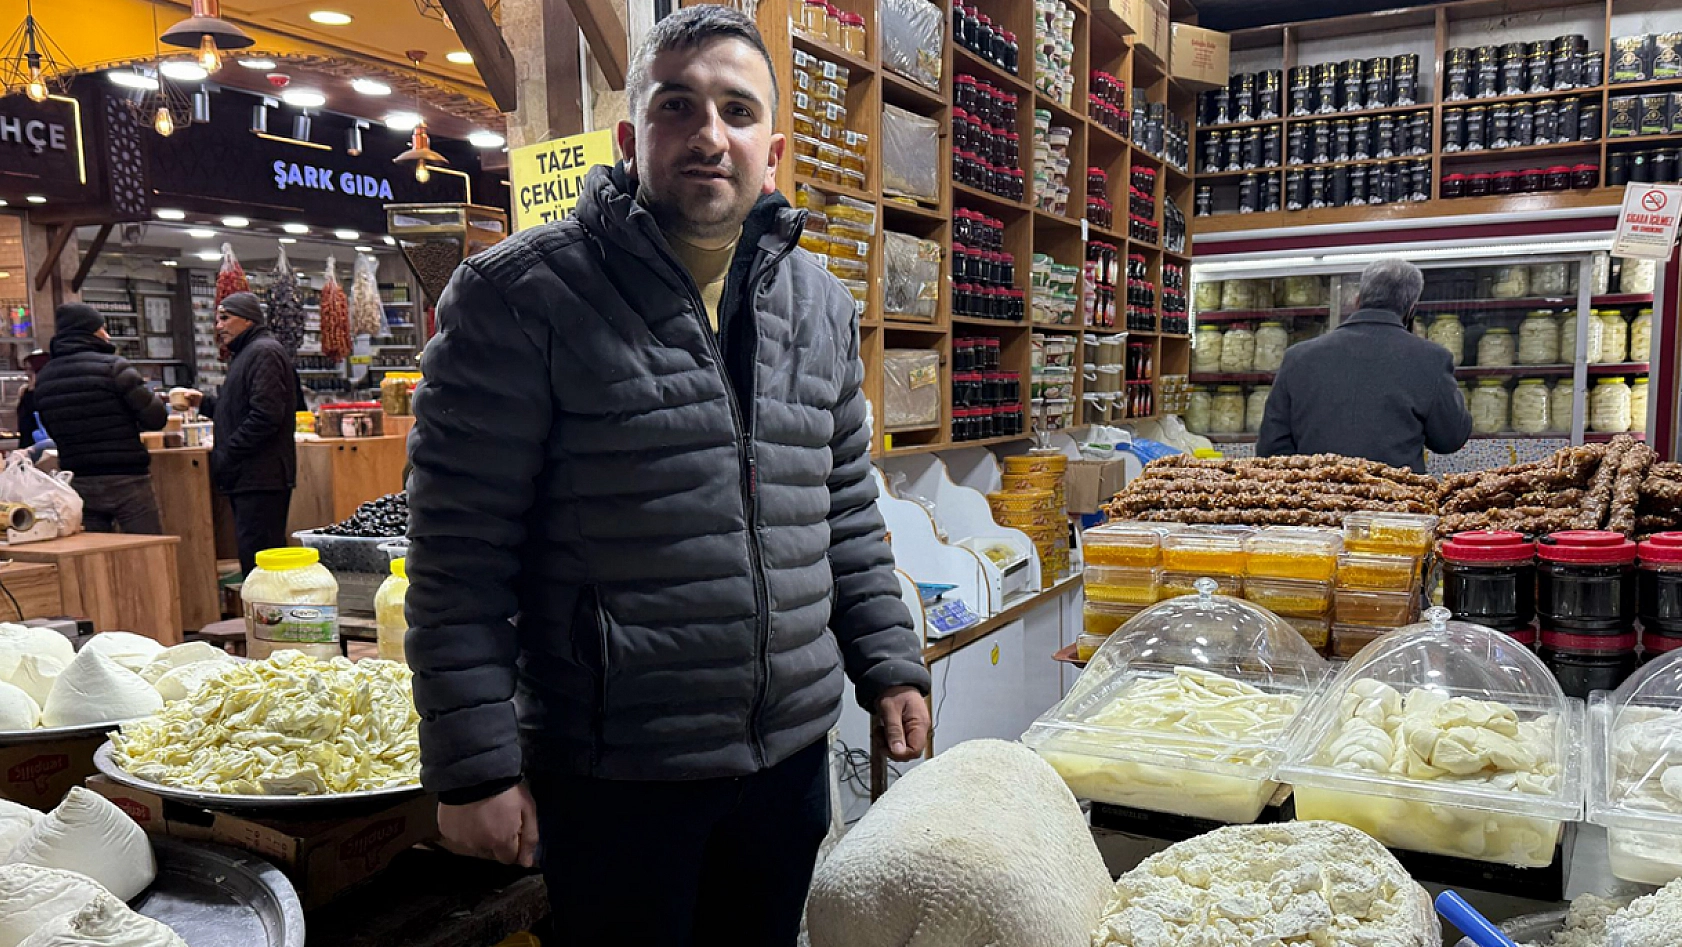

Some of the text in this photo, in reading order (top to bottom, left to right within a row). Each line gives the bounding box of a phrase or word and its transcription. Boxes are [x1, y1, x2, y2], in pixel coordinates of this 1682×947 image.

[536, 144, 585, 174] TAZE
[273, 160, 394, 200] ŞARK GIDA
